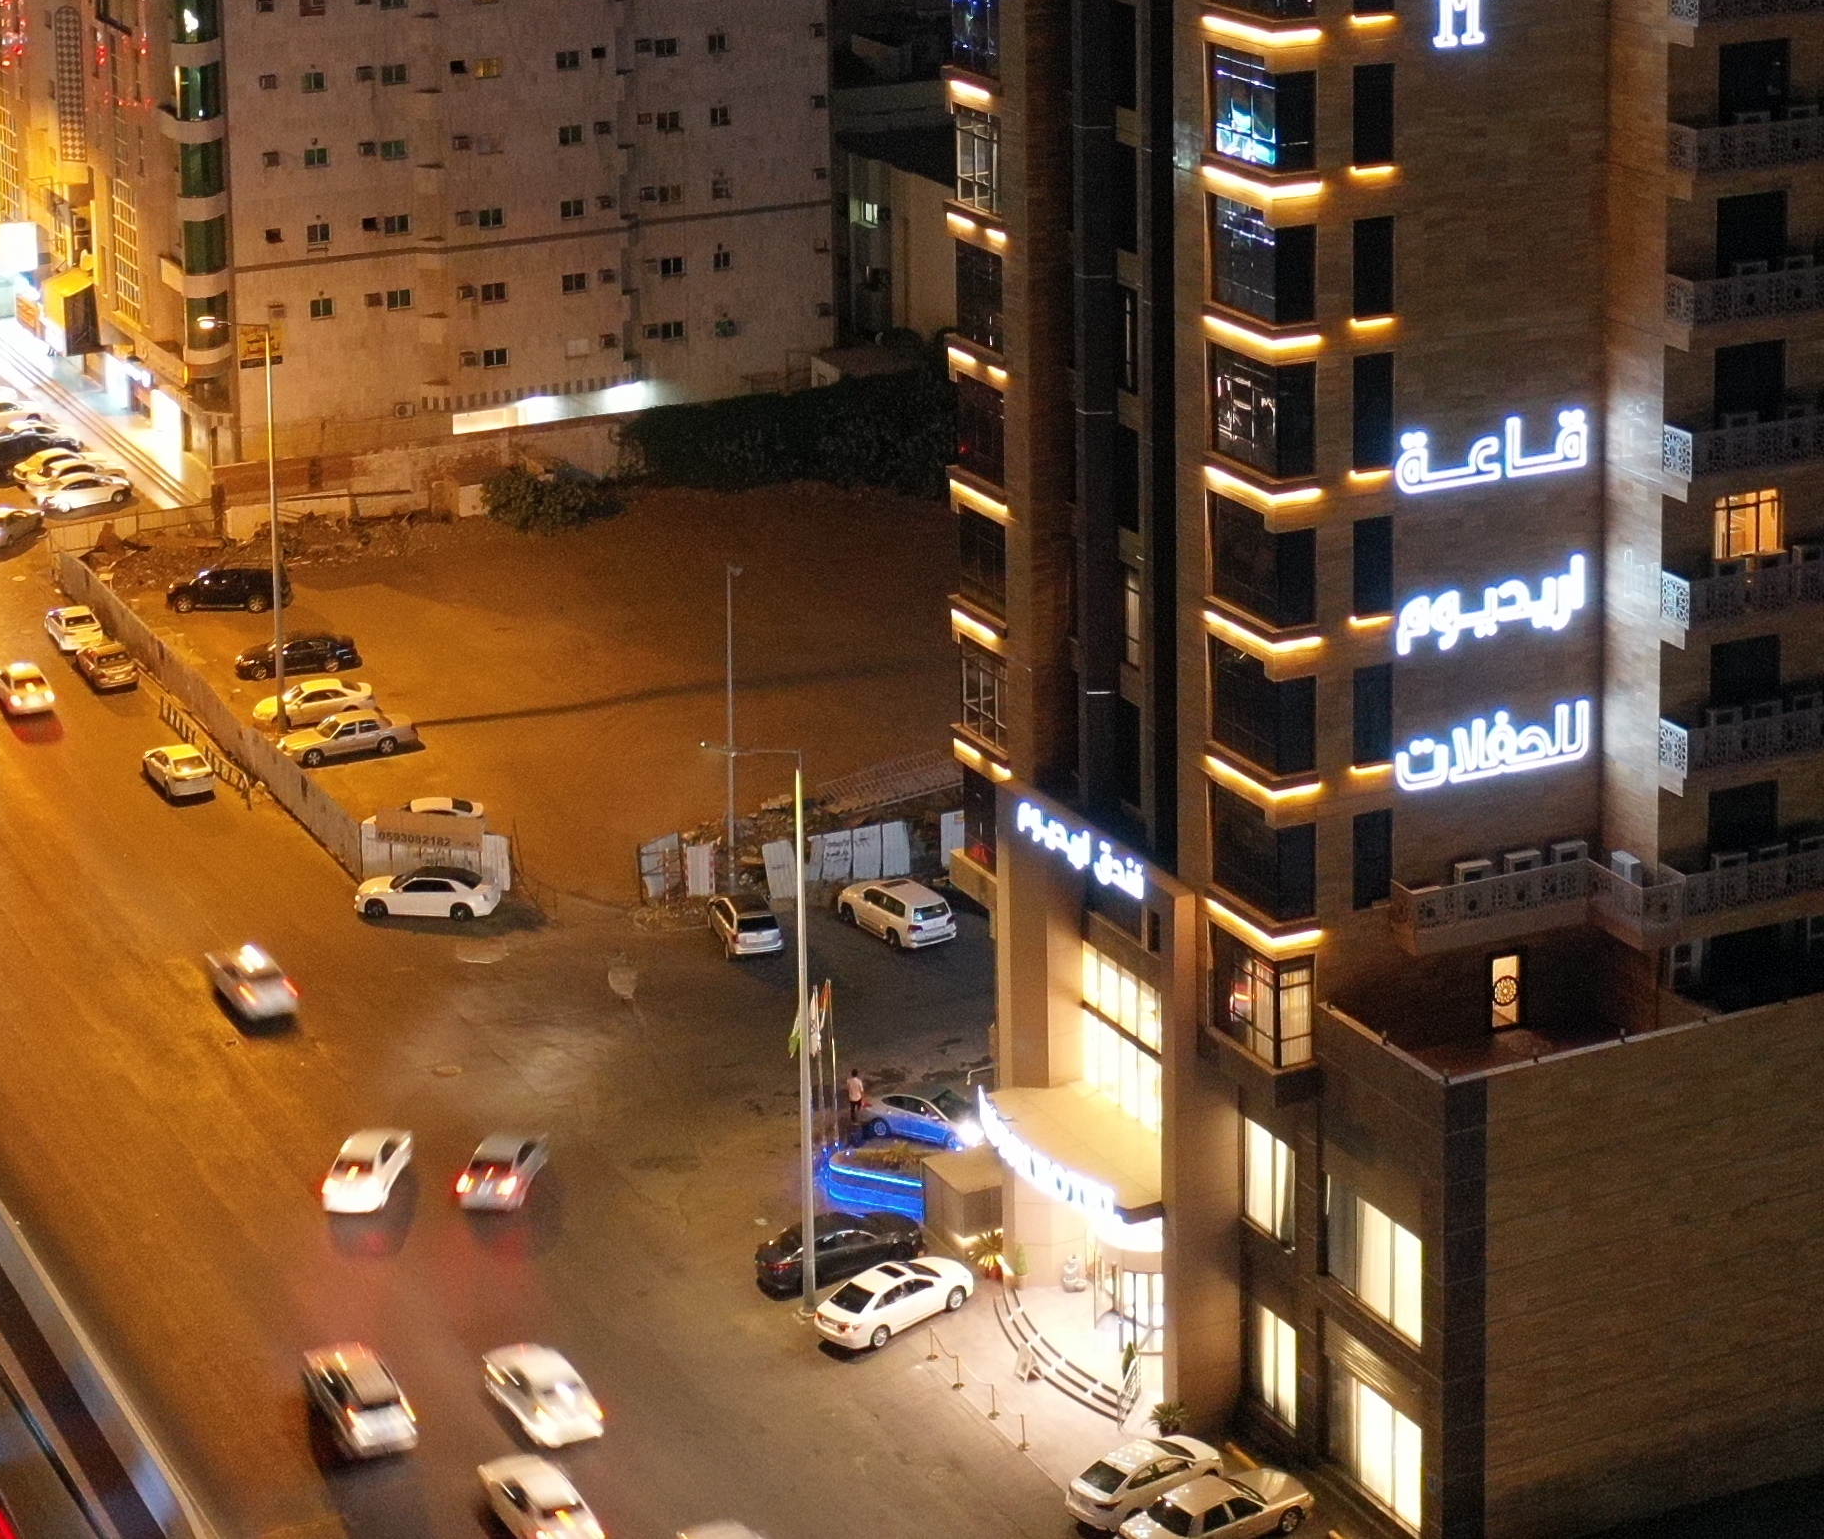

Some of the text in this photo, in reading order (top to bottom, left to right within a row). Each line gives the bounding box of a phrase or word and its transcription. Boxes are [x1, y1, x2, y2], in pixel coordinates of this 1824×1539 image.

[1394, 408, 1590, 495] قاعة
[1393, 699, 1592, 793] للحفلات
[1093, 840, 1144, 900] فندق
